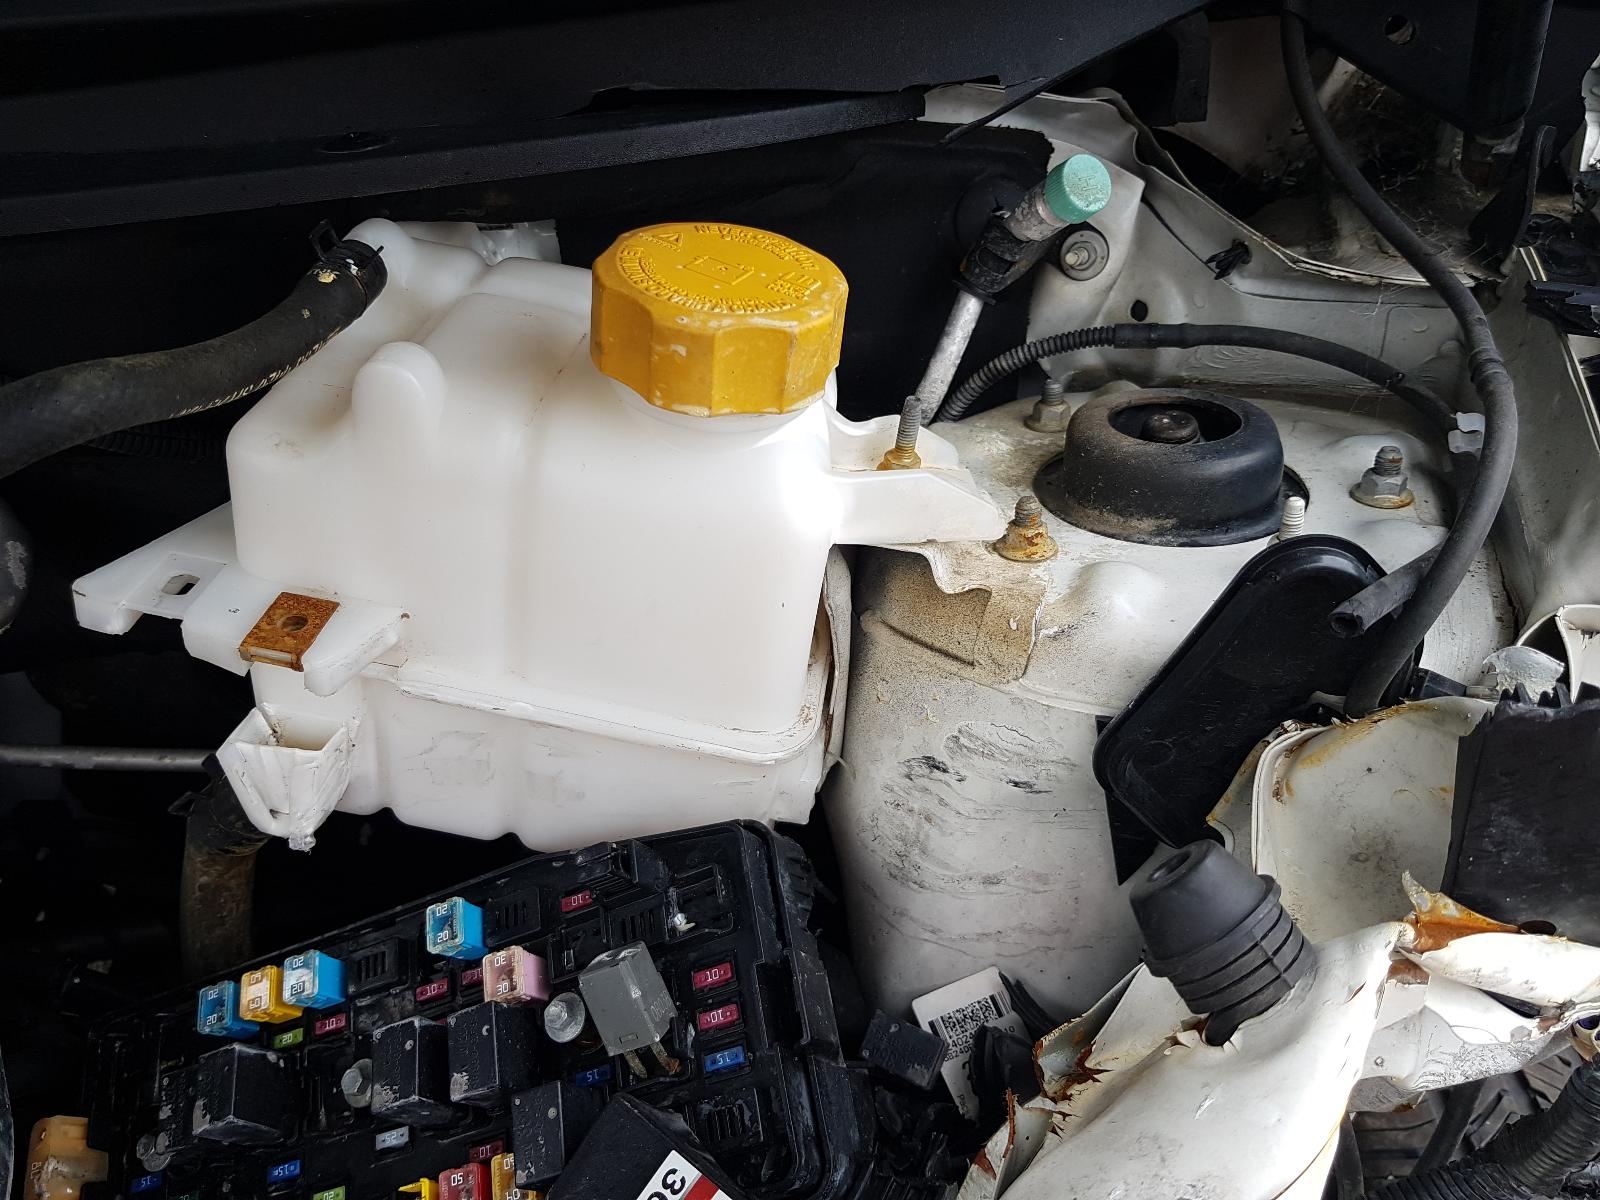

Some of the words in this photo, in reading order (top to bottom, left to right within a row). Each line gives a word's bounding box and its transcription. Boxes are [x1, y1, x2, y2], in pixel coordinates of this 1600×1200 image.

[694, 224, 752, 238] NEVER
[754, 232, 798, 252] OPEN
[617, 255, 656, 286] JAMAIS
[642, 284, 710, 311] OUVRIR
[571, 894, 583, 906] 10
[436, 905, 448, 916] 20
[437, 930, 449, 943] 20
[293, 956, 304, 968] 20
[494, 952, 507, 967] 30
[706, 968, 719, 982] 10
[208, 988, 219, 1000] 20
[292, 982, 304, 993] 20
[426, 984, 437, 996] 10
[496, 982, 509, 995] 30
[206, 1013, 217, 1026] 20
[710, 1009, 723, 1023] 10
[325, 1018, 336, 1030] 10
[282, 1033, 293, 1044] 20
[716, 1051, 730, 1065] 15
[587, 1068, 600, 1082] 15
[385, 1131, 397, 1144] 25
[479, 1144, 492, 1158] 10
[278, 1165, 289, 1177] 15
[141, 1176, 151, 1187] 15
[451, 1172, 464, 1187] 50
